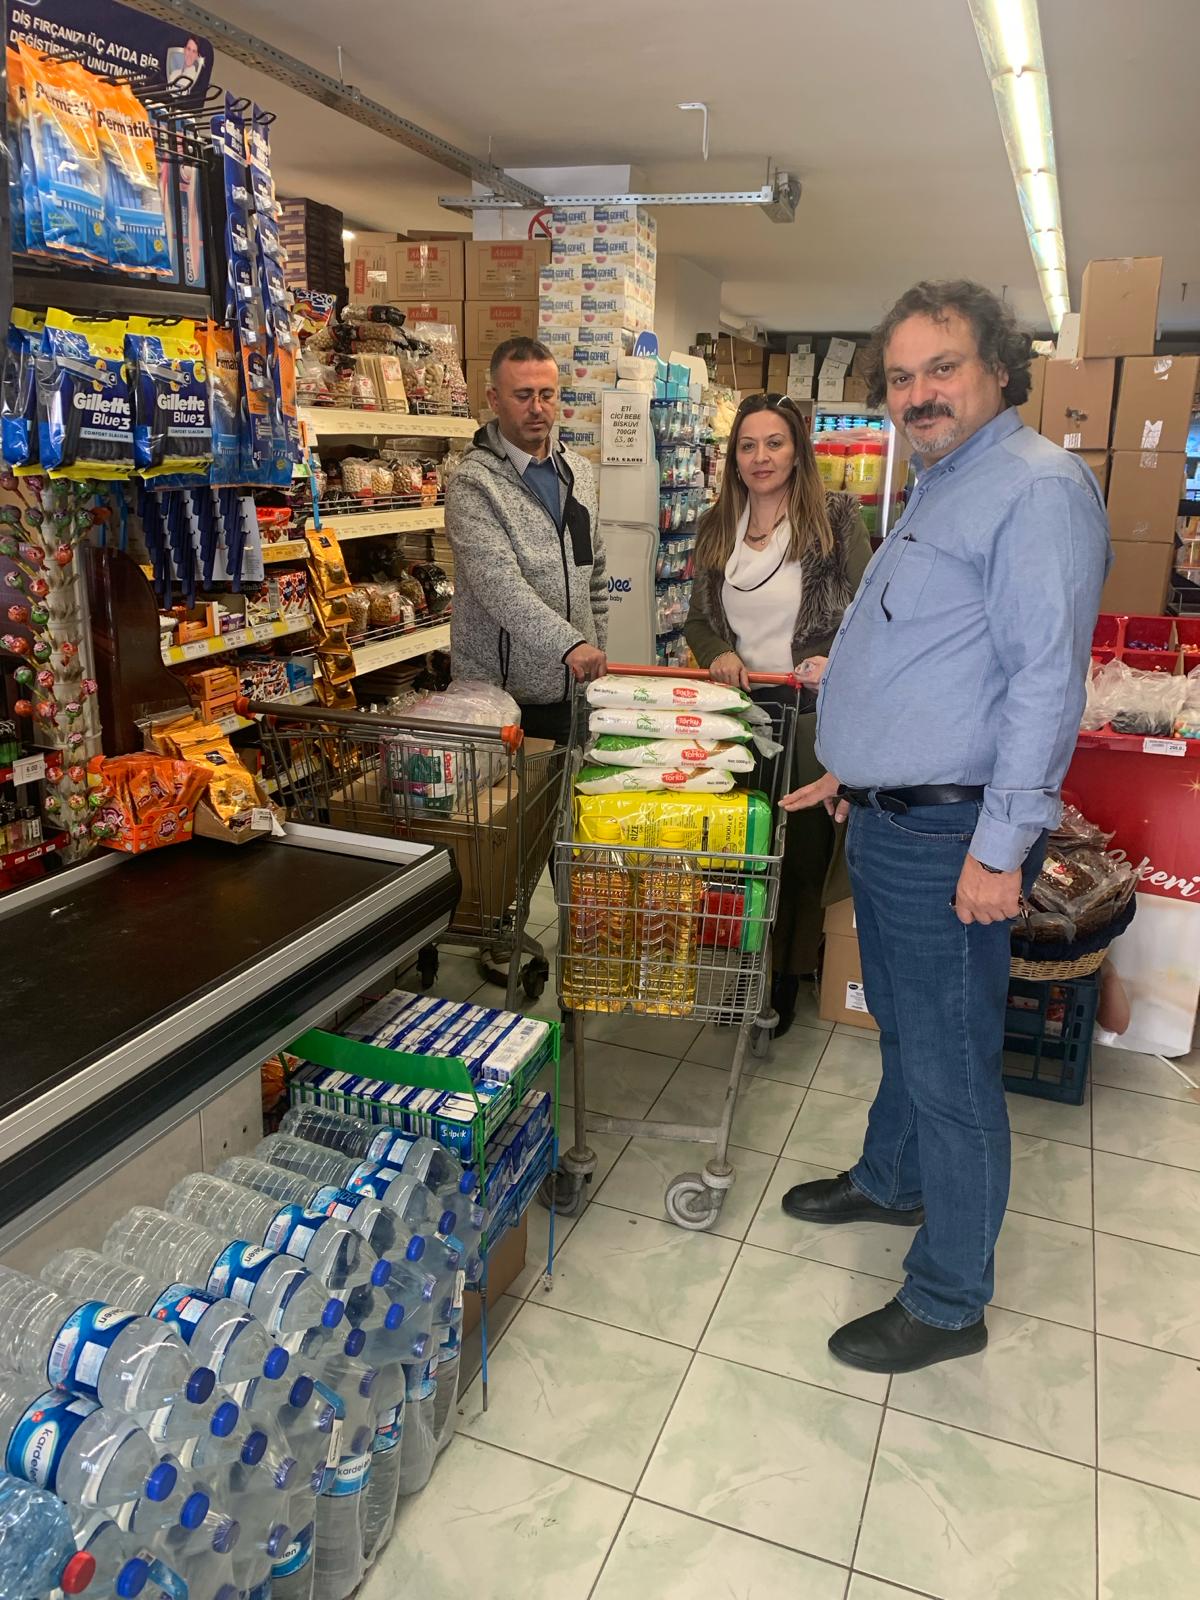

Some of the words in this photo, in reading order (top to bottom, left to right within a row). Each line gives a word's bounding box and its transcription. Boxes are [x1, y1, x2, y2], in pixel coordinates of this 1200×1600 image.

[12, 9, 31, 30] DİŞ
[88, 32, 105, 56] ÜÇ
[106, 42, 138, 65] AYDA
[97, 111, 151, 138] Permatik
[73, 392, 131, 416] Gillette
[157, 393, 206, 412] Gillette
[92, 412, 132, 431] Blue3
[173, 411, 205, 426] Blue3
[679, 716, 700, 726] Torku
[683, 750, 706, 759] Torku
[663, 773, 685, 782] Torku
[630, 825, 639, 842] RİZE
